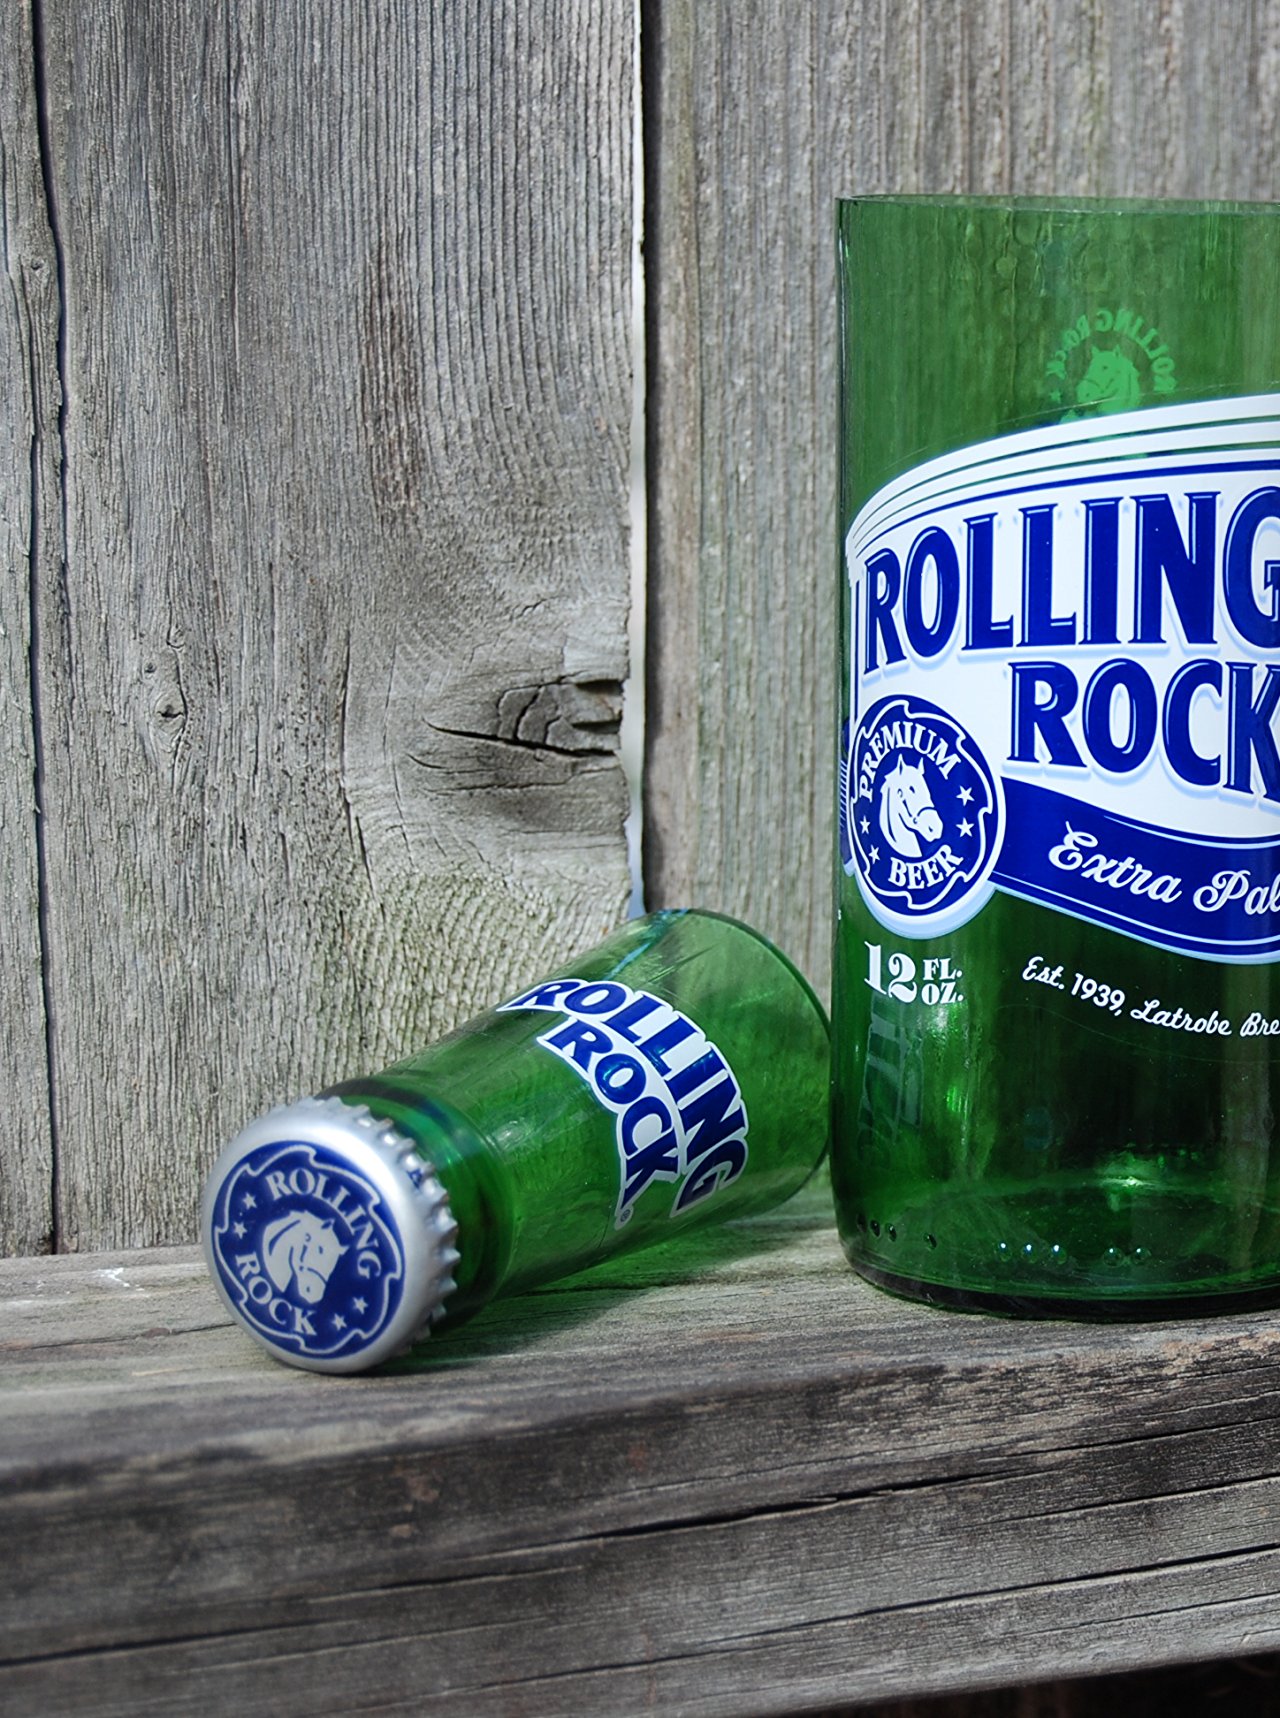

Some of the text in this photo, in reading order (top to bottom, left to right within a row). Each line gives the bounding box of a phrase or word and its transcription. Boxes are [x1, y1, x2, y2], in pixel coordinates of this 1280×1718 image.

[858, 720, 962, 803] PREMIUM
[887, 843, 964, 890] BEER
[1048, 820, 1183, 904] Extra
[864, 940, 963, 1003] 12 FL.
[921, 981, 964, 1006] OZ.
[1021, 955, 1065, 990] Est.
[1070, 972, 1126, 1017] 1939,
[1129, 999, 1233, 1036] Latrobe
[498, 979, 749, 1217] ROLLING
[538, 1018, 682, 1215] ROCK
[265, 1167, 383, 1280] ROLLING
[234, 1251, 318, 1337] ROCK
